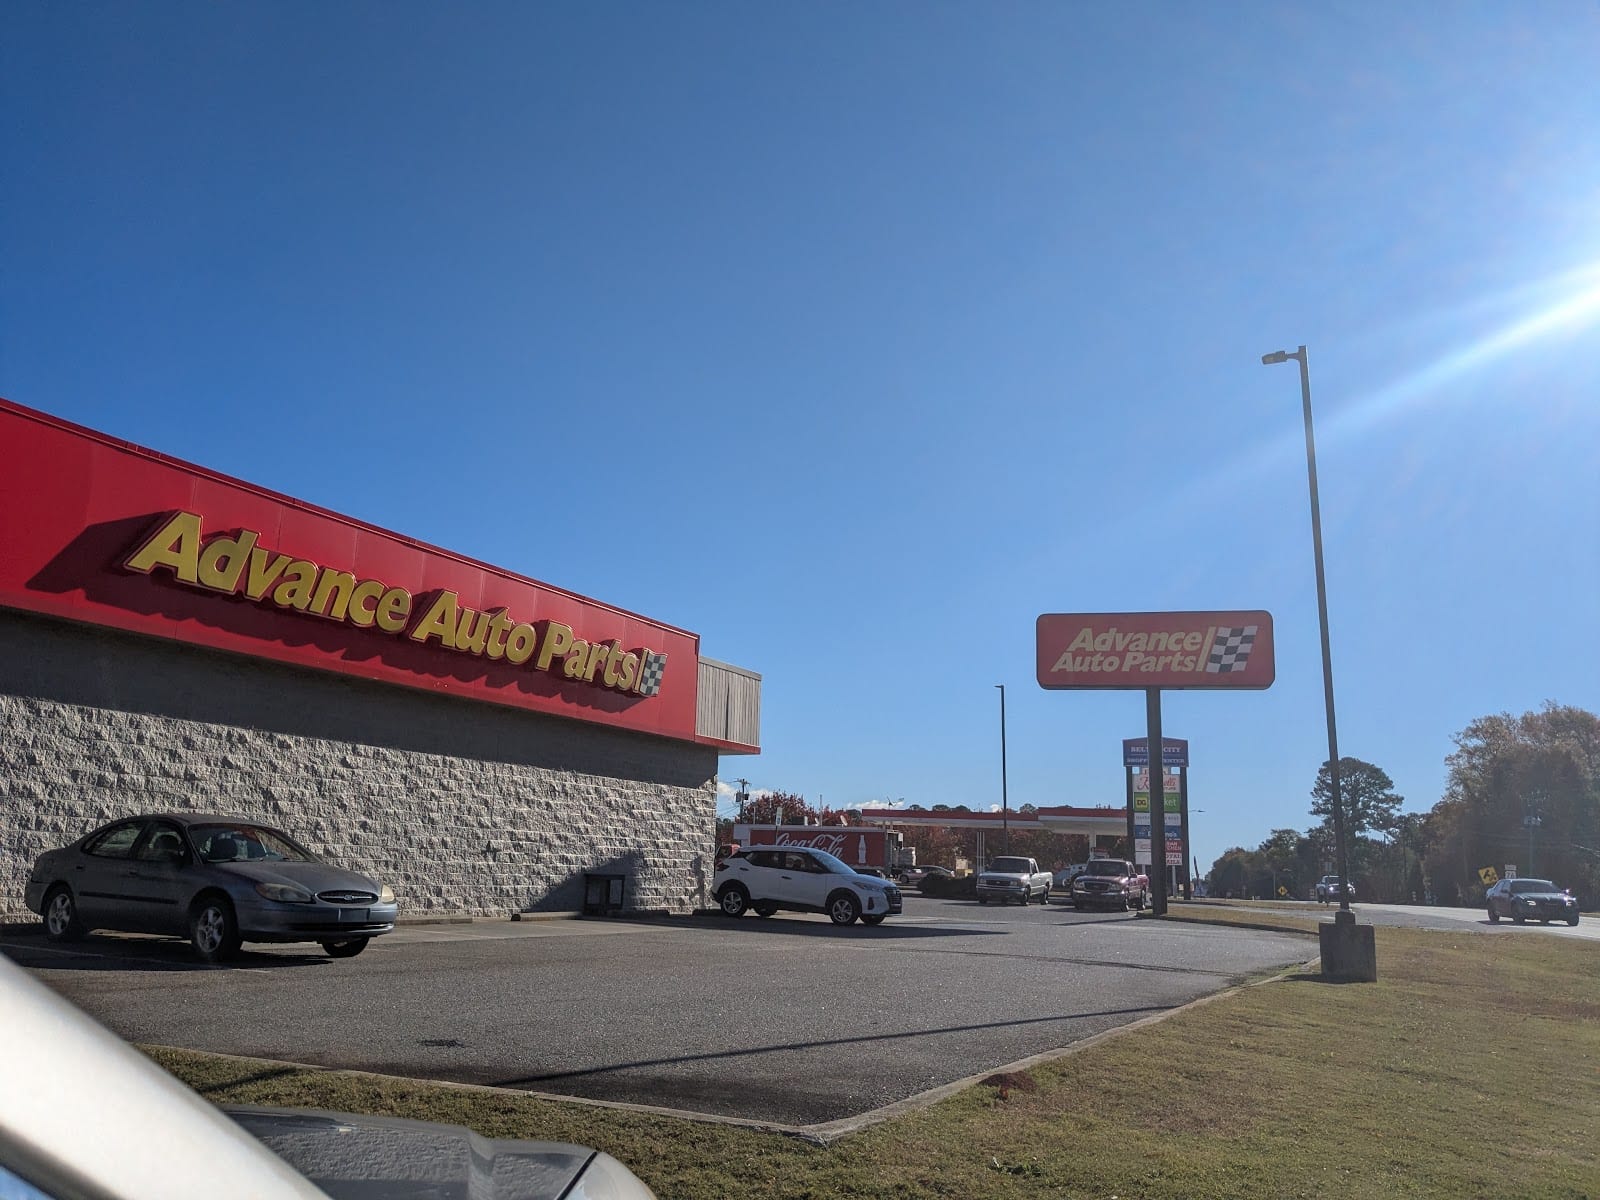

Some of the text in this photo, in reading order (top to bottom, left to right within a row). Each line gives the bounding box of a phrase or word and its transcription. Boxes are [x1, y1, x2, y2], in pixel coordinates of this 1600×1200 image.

[124, 510, 638, 692] Advance Auto Parts
[1065, 627, 1203, 652] Advance
[1051, 651, 1194, 673] Auto Parts
